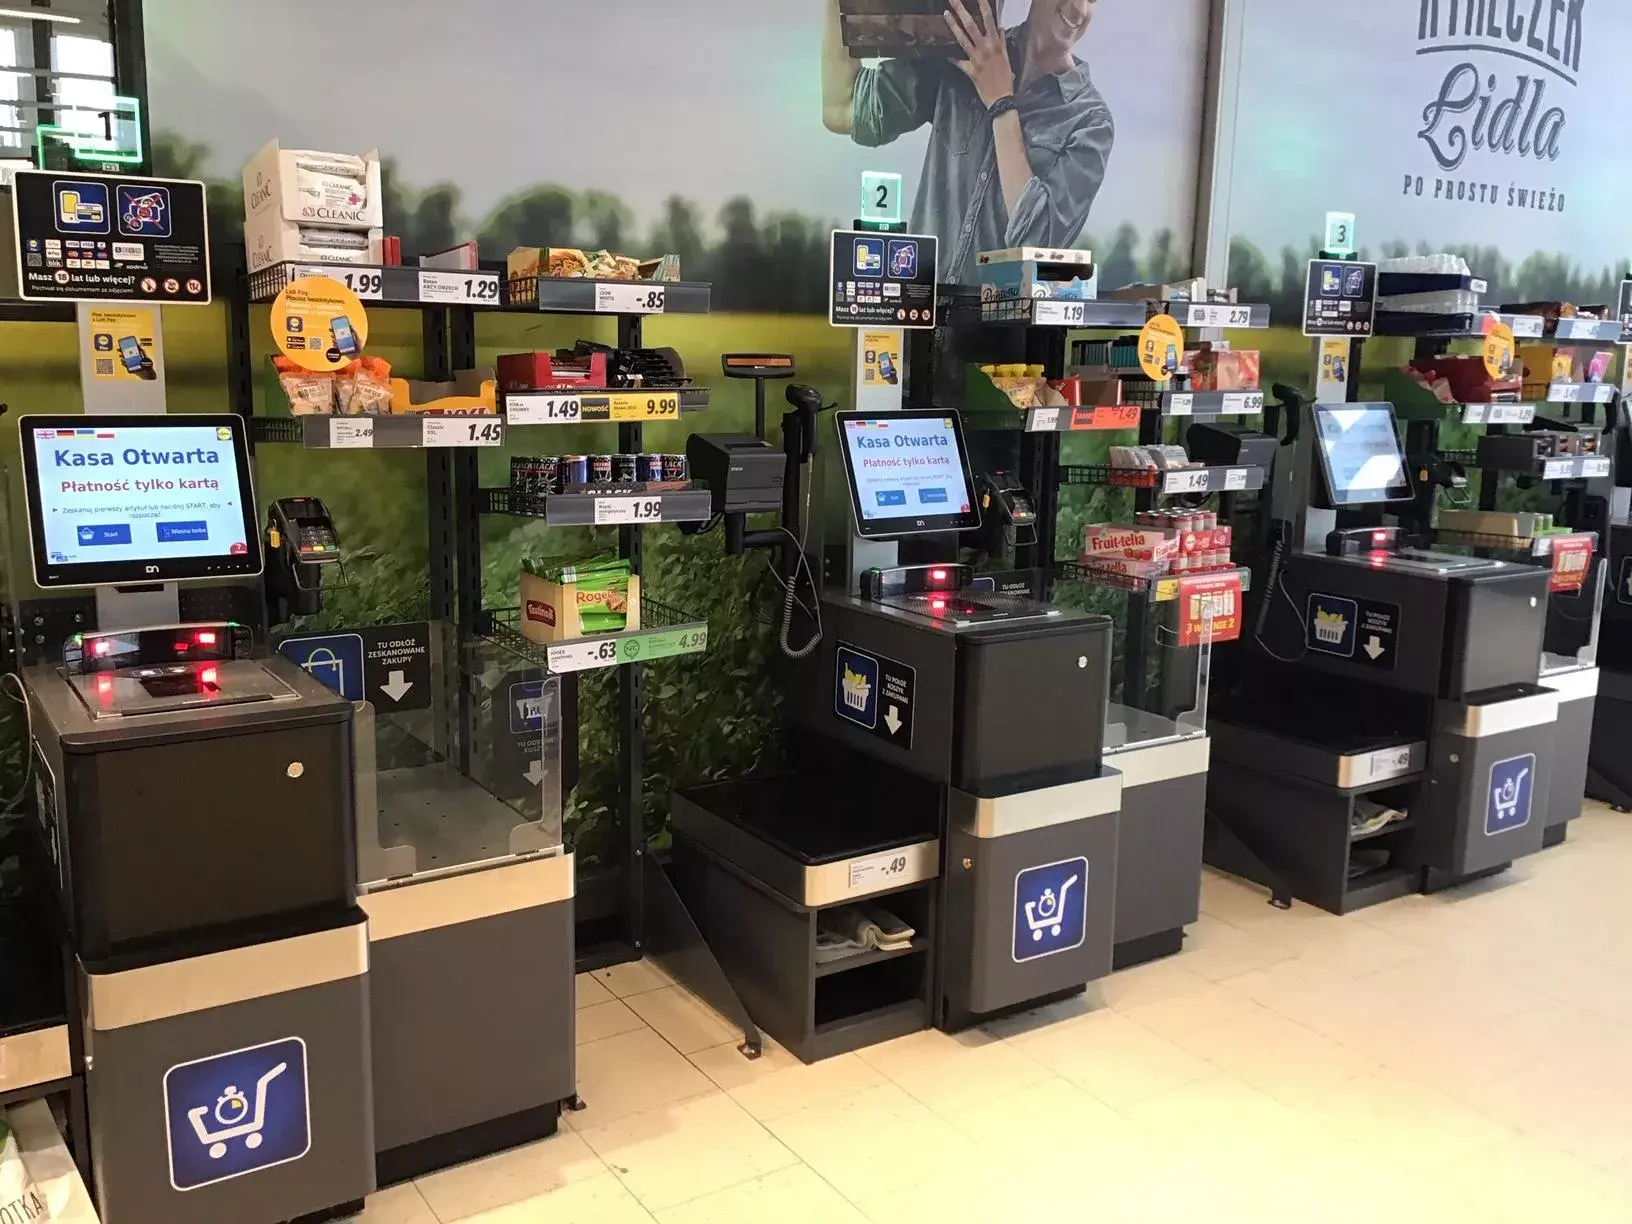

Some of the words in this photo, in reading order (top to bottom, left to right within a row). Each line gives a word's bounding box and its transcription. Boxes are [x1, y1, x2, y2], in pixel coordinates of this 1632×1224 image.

[1417, 62, 1565, 172] Lidla
[97, 111, 112, 141] 1
[328, 181, 353, 191] CLEANIC
[1403, 174, 1423, 196] PO
[1434, 178, 1498, 205] PROSTU
[1507, 181, 1565, 212] ŚWIEŻO
[875, 185, 888, 208] 2
[317, 207, 366, 222] CLEANIC
[1337, 224, 1346, 243] 3
[28, 272, 52, 280] Masz
[71, 274, 82, 282] lat
[86, 274, 100, 282] lub
[102, 275, 136, 285] więcej?
[345, 272, 382, 294] 1.99
[464, 280, 498, 298] 1.29
[636, 292, 664, 308] -.85
[1064, 306, 1083, 320] 1.19
[1229, 310, 1248, 323] 2.79
[547, 400, 578, 418] 1.49
[646, 399, 676, 414] 9.99
[1244, 397, 1262, 408] 6.99
[1119, 408, 1138, 420] 1.49
[356, 428, 373, 437] 2.49
[468, 423, 501, 441] 1.45
[856, 436, 890, 449] Kasa
[894, 434, 948, 448] Otwarta
[54, 448, 114, 468] Kasa
[123, 448, 219, 465] Otwarta
[863, 458, 902, 468] Płatność
[904, 456, 925, 467] tylko
[927, 456, 950, 466] kartą
[60, 477, 130, 493] Płatność
[134, 478, 174, 495] tylko
[178, 476, 219, 492] kartą
[1188, 473, 1208, 487] 1.49
[62, 506, 92, 515] Zeskanuj
[94, 506, 122, 514] pierwszy
[124, 504, 148, 512] artykuł
[209, 502, 221, 510] aby
[633, 502, 661, 518] 1.99
[1092, 533, 1145, 550] Fruit-tella
[1228, 618, 1235, 628] 2
[389, 638, 416, 648] ODŁÓŻ
[679, 632, 706, 648] 4.99
[368, 647, 425, 658] ZESKANOWANE
[587, 642, 616, 660] -.63
[382, 656, 412, 665] ZAKUPY
[885, 674, 891, 682] TU
[888, 683, 904, 694] KOSZYK
[881, 856, 906, 875] -.49
